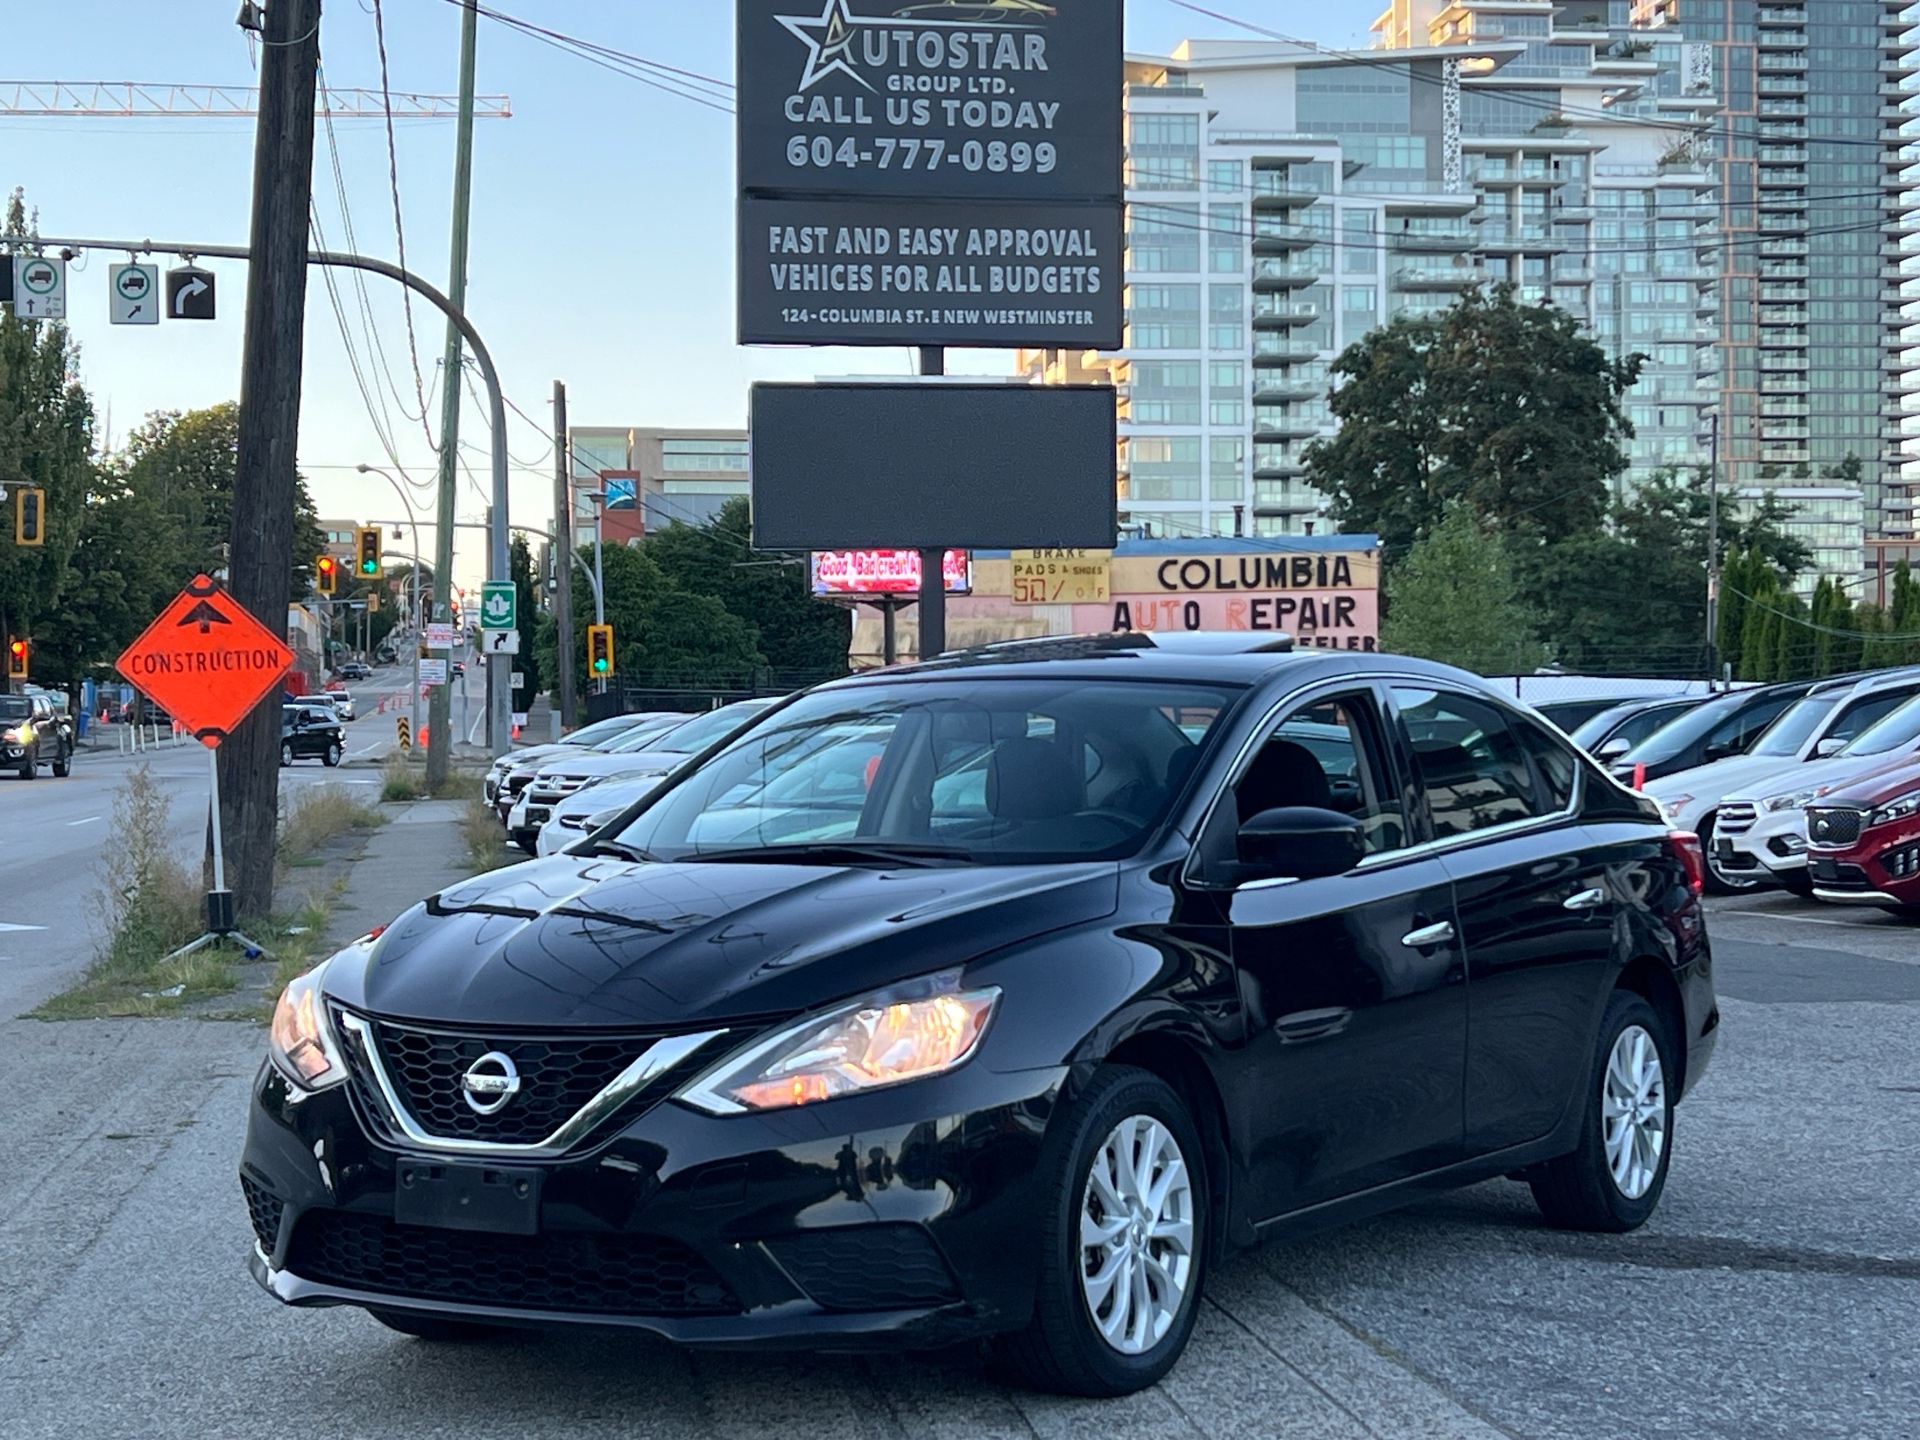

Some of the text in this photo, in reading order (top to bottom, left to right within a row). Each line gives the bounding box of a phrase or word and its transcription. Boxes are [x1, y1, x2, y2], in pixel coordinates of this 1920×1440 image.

[817, 10, 1048, 71] AUTOSTAR
[887, 74, 1016, 95] GROUP LTD.
[784, 95, 1060, 129] CALL US TODAY
[786, 135, 1057, 173] 604-777-0899
[769, 226, 1097, 257] FAST AND EASY APPROVAL
[770, 263, 1101, 294] VEHICES FOR ALL BUDGETS
[944, 309, 979, 325] NEW
[984, 309, 1094, 326] WESTMINSTER
[1033, 549, 1086, 559] BRAKE
[1014, 564, 1056, 576] PADS
[1157, 555, 1352, 590] COLUMBIA
[494, 600, 499, 612] 1
[1113, 596, 1356, 631] AUTO REPAIR
[132, 649, 278, 675] CONSTRUCTION
